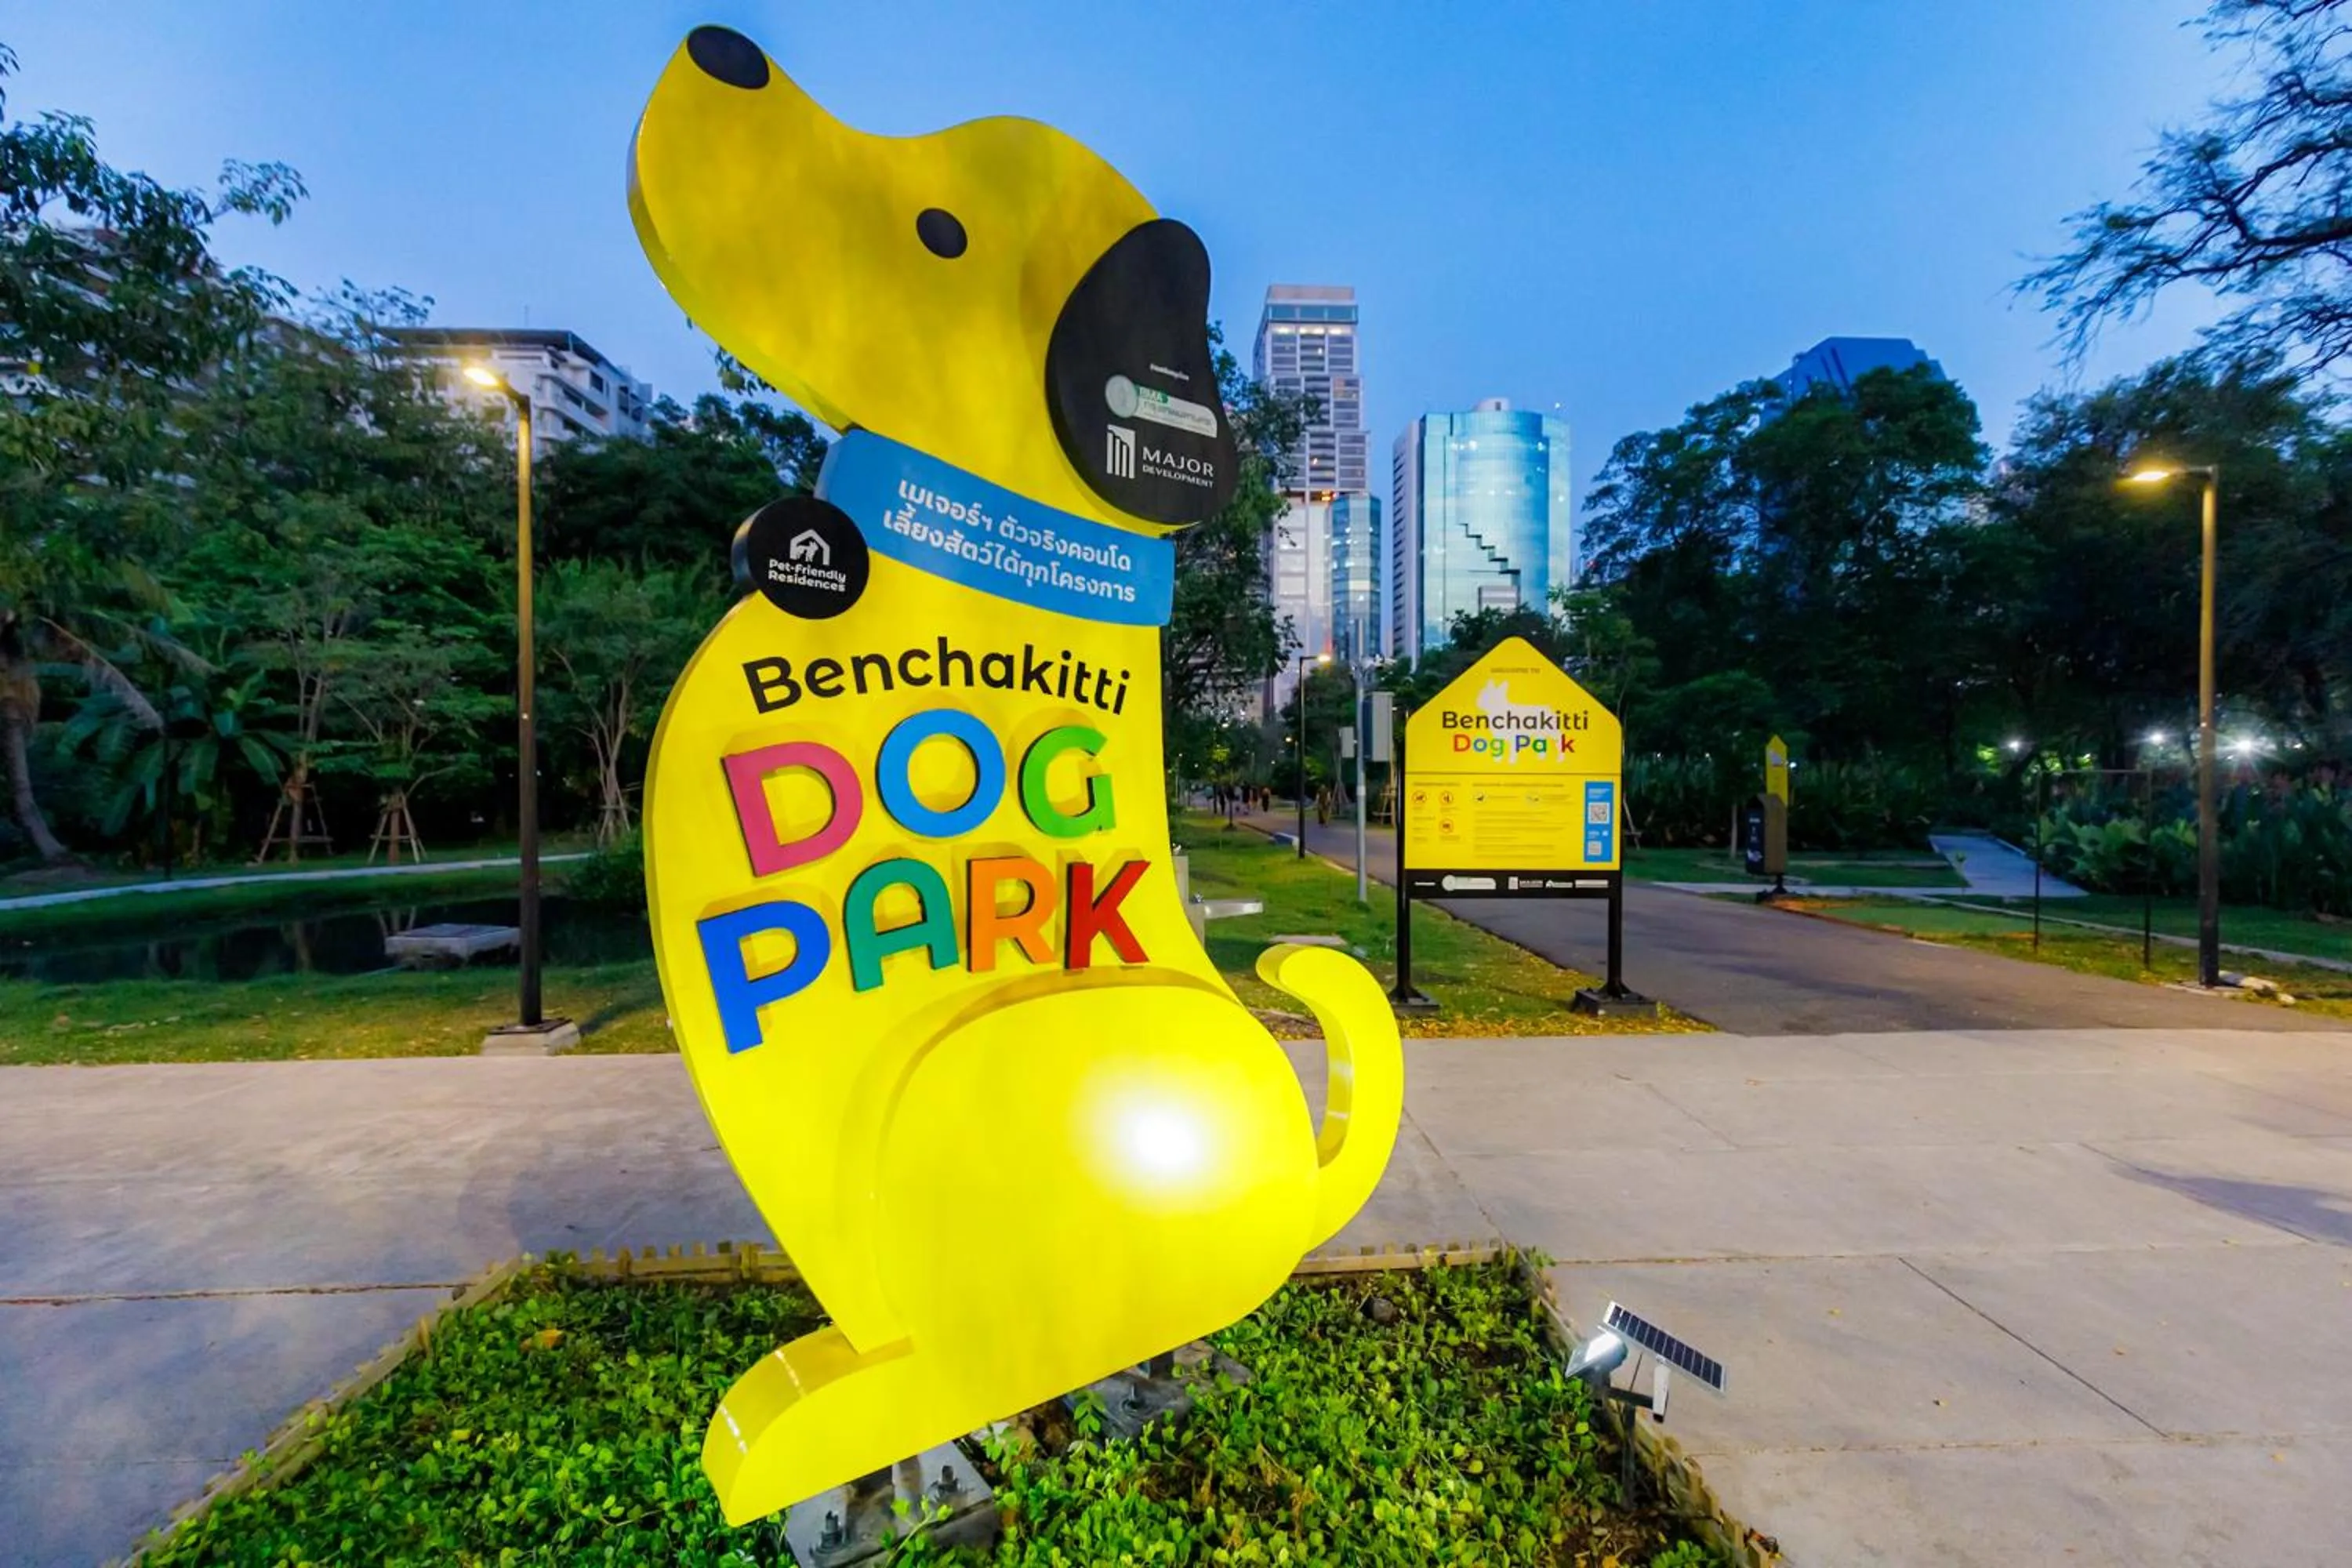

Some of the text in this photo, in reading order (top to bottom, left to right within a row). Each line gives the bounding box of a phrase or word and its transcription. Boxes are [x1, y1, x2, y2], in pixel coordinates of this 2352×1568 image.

[1142, 446, 1214, 478] MAJOR
[1142, 464, 1214, 489] DEVELOPMENT
[898, 478, 1132, 572] เมเจอร์ฯ ตัวจริงคอนโด
[883, 503, 1136, 603] เลี้ยงสัตว์ได้ทุกโครงการ
[768, 558, 847, 584] Pet-Friendly
[768, 570, 846, 593] Residences
[742, 636, 1131, 715] Benchakitti
[1441, 710, 1588, 731] Benchakitti
[1453, 734, 1576, 757] Dog Pak
[720, 708, 1116, 878] DOG
[696, 857, 1151, 1054] PARK
